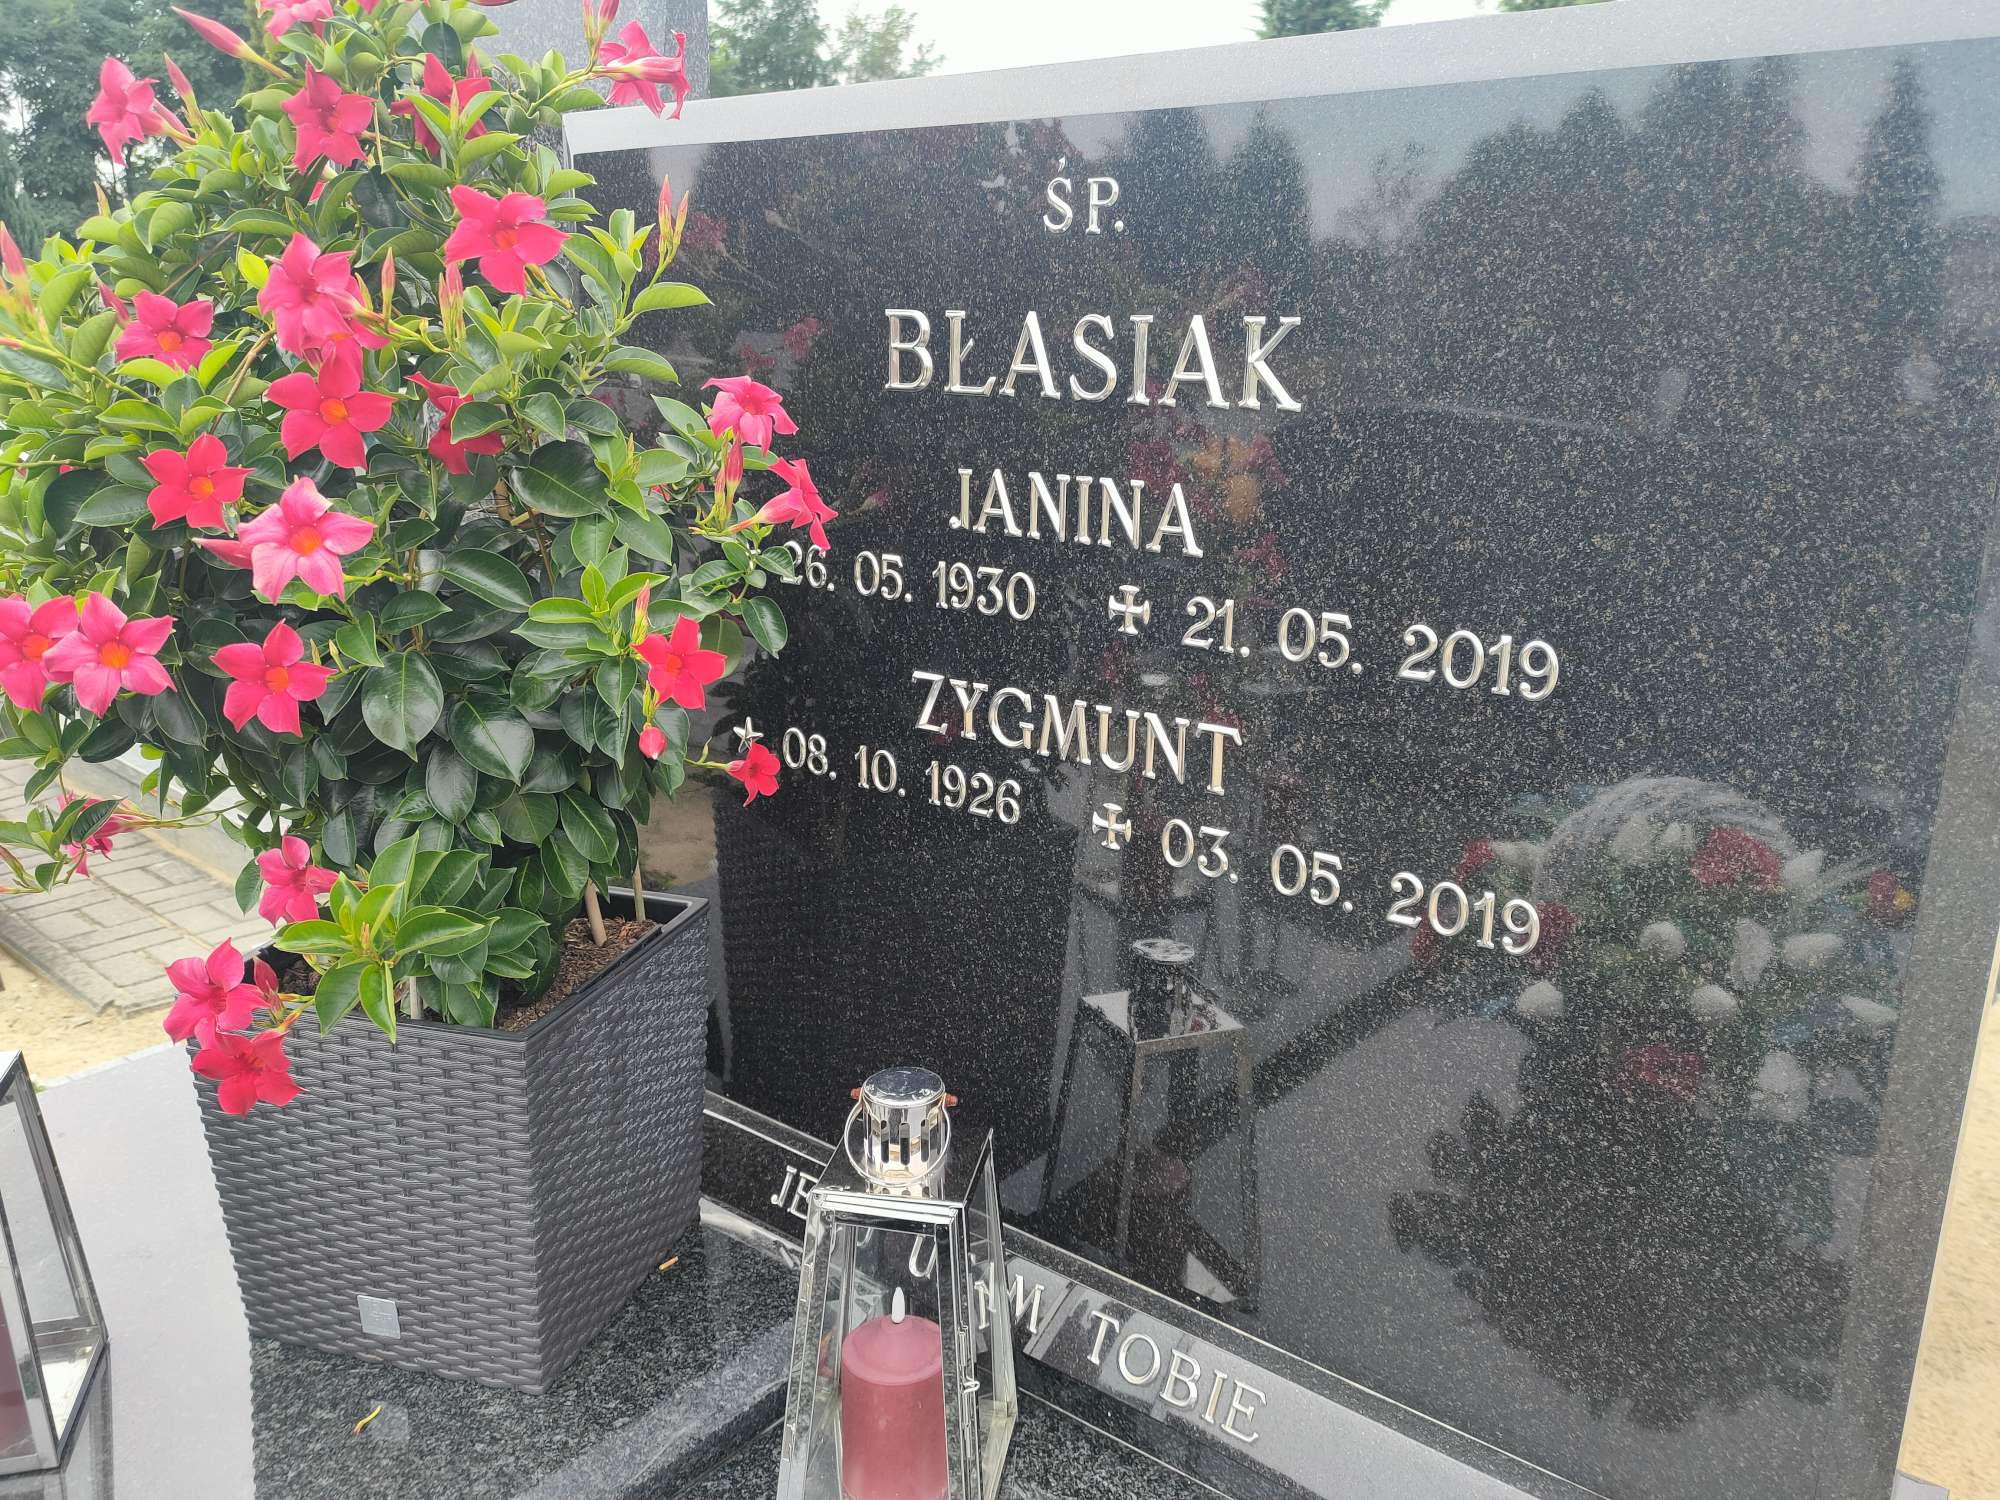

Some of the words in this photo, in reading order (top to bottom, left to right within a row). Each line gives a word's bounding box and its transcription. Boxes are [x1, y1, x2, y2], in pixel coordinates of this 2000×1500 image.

[884, 308, 1302, 412] BŁASIAK
[949, 468, 1203, 558] JANINA
[780, 540, 835, 591] 26.
[854, 550, 912, 603] 05.
[932, 560, 1036, 621] 1930
[1181, 596, 1250, 657] 21.
[1278, 607, 1362, 674] 05.
[1400, 624, 1560, 701] 2019
[911, 671, 1242, 796] ZYGMUNT
[782, 727, 837, 780] 08.
[855, 744, 906, 797] 10.
[926, 760, 1022, 825] 1926
[1162, 818, 1239, 884] 03.
[1271, 844, 1354, 913] 05.
[1386, 871, 1540, 957] 2019
[1087, 1309, 1267, 1443] TOBIE
